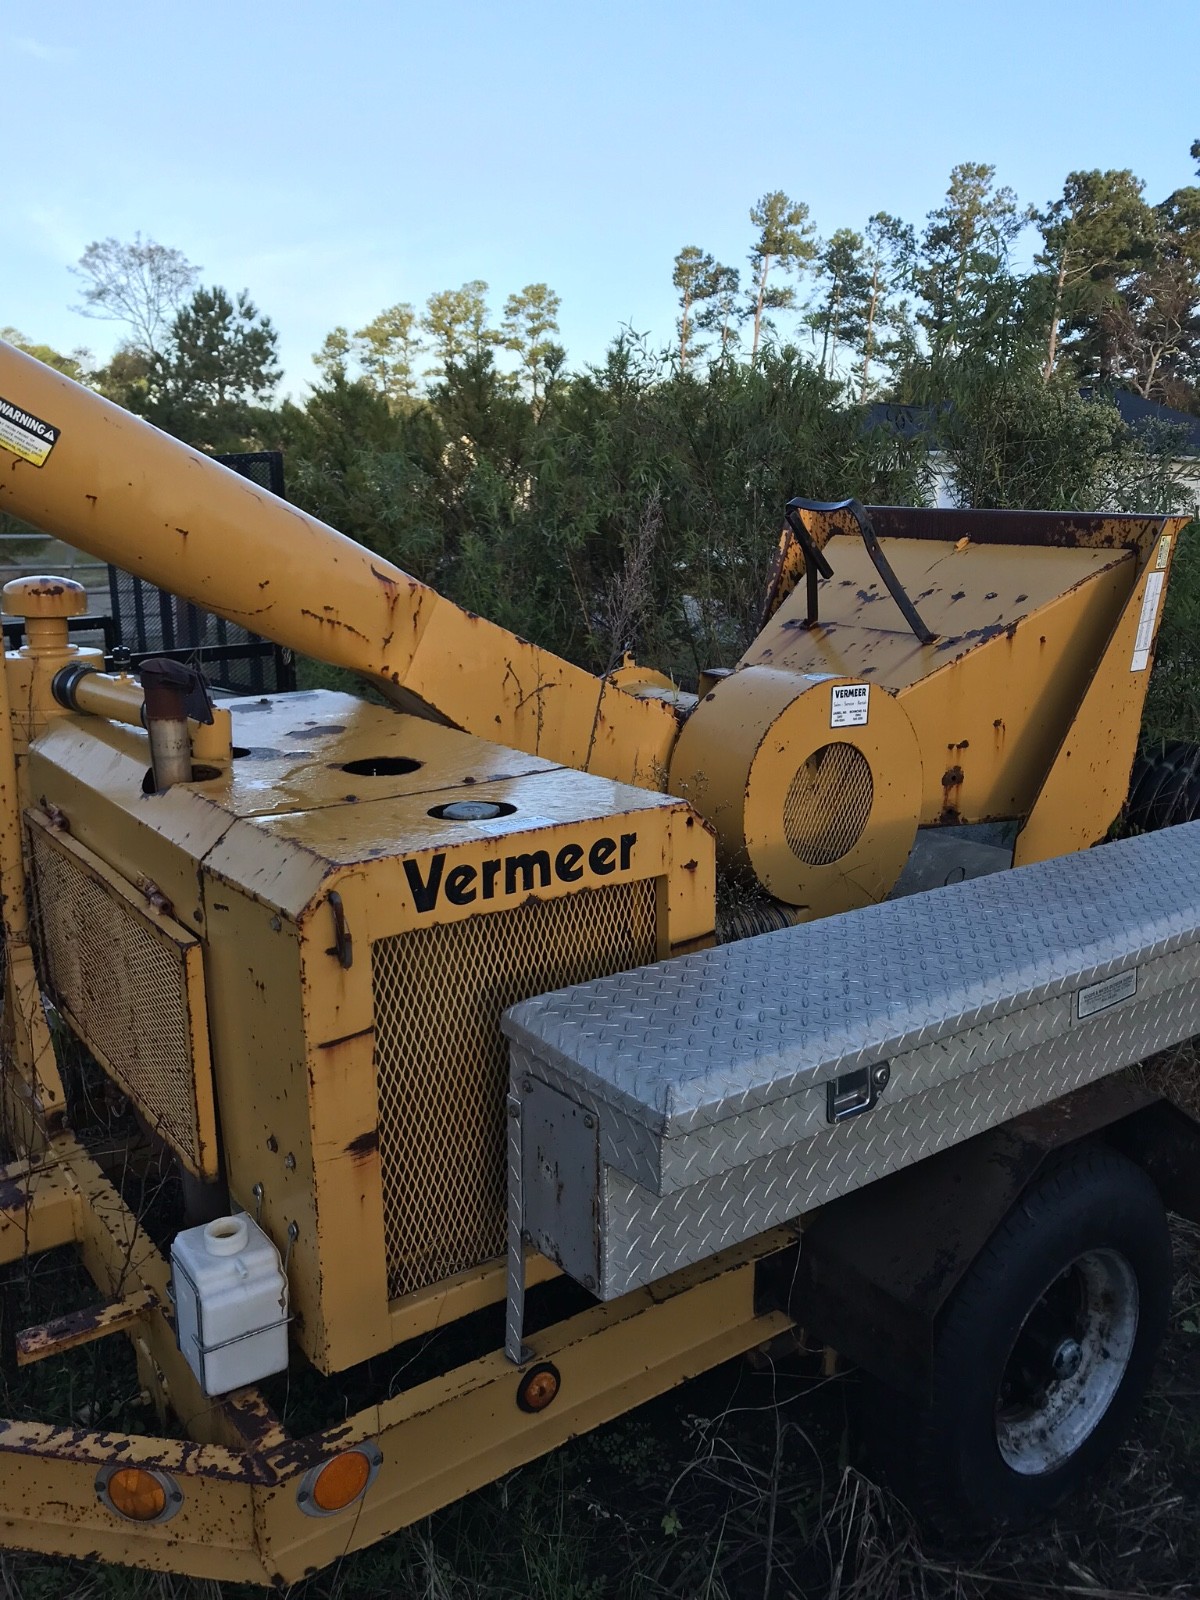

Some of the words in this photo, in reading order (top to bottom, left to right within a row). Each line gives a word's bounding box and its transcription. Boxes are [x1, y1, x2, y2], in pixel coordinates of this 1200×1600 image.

[0, 401, 46, 435] WARNING
[835, 688, 867, 699] VERMEER
[402, 832, 637, 913] Vermeer
